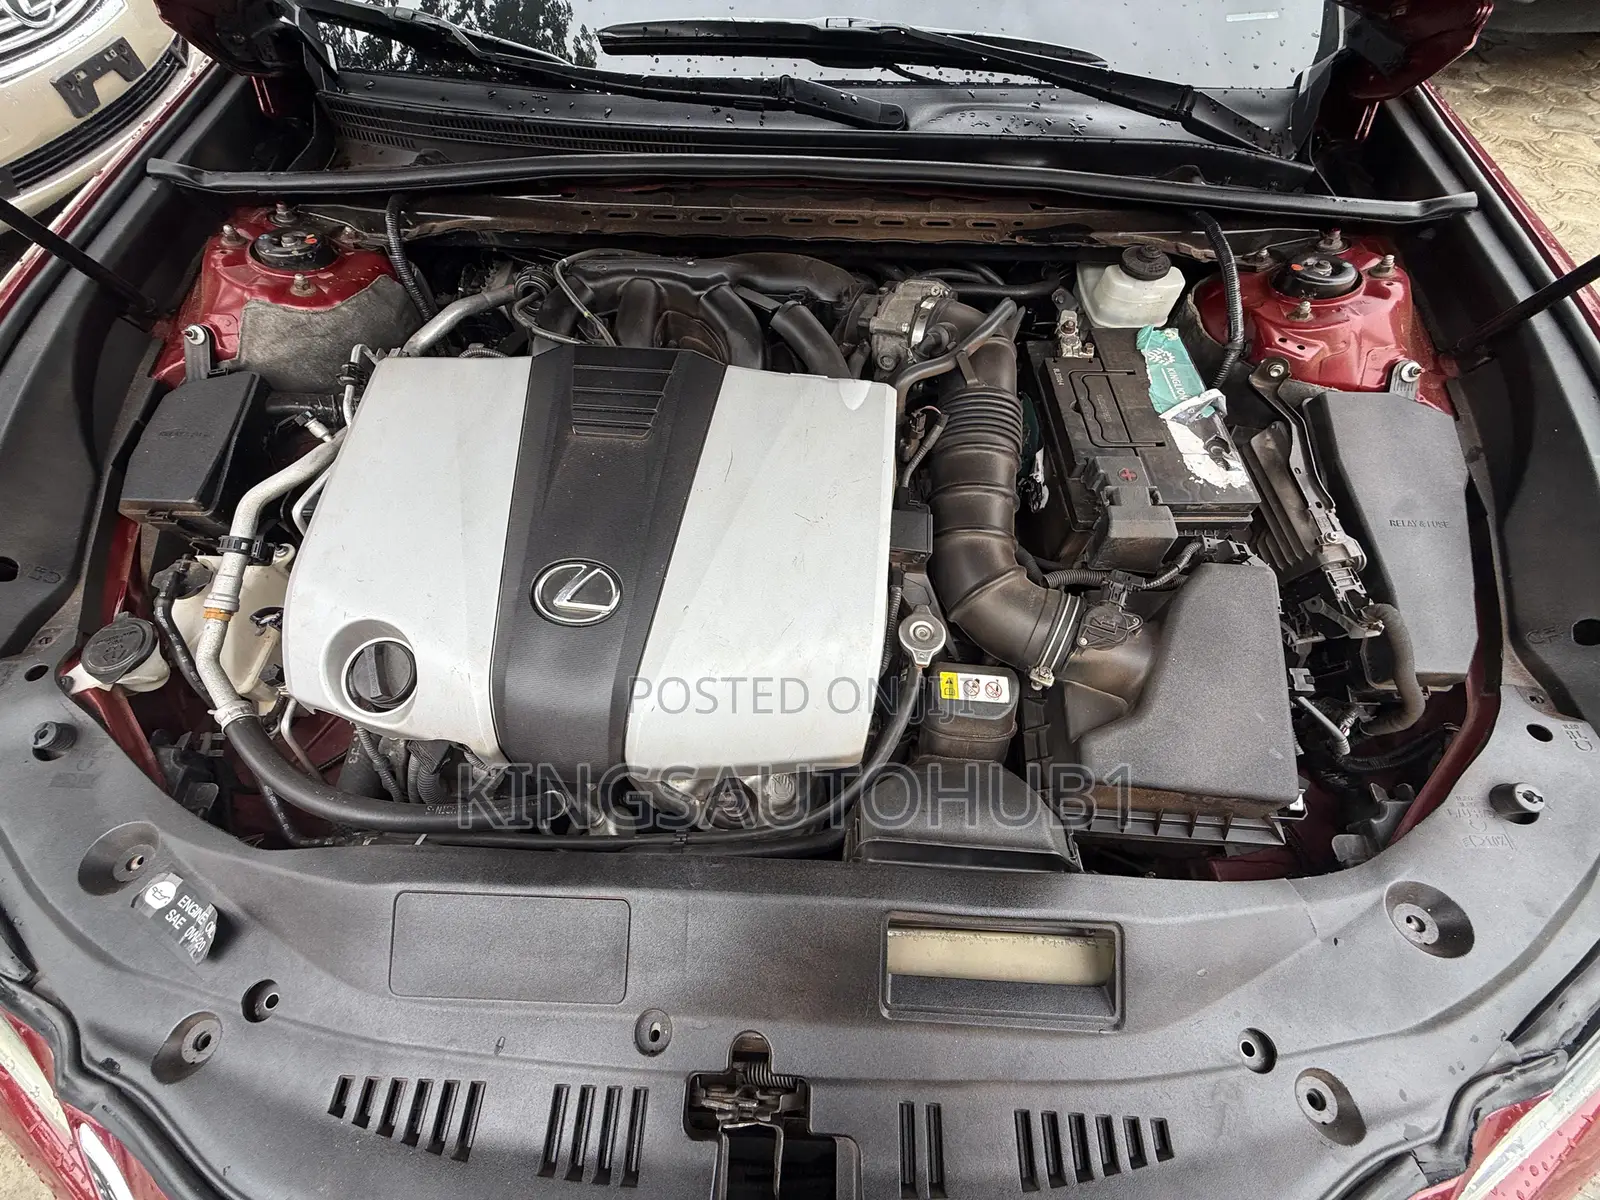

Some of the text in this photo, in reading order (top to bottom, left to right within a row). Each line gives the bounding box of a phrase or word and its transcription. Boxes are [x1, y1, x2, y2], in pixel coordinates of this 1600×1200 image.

[1389, 519, 1417, 527] RELAY
[177, 895, 209, 925] ENGINE
[164, 908, 207, 953] SAE 0W-20
